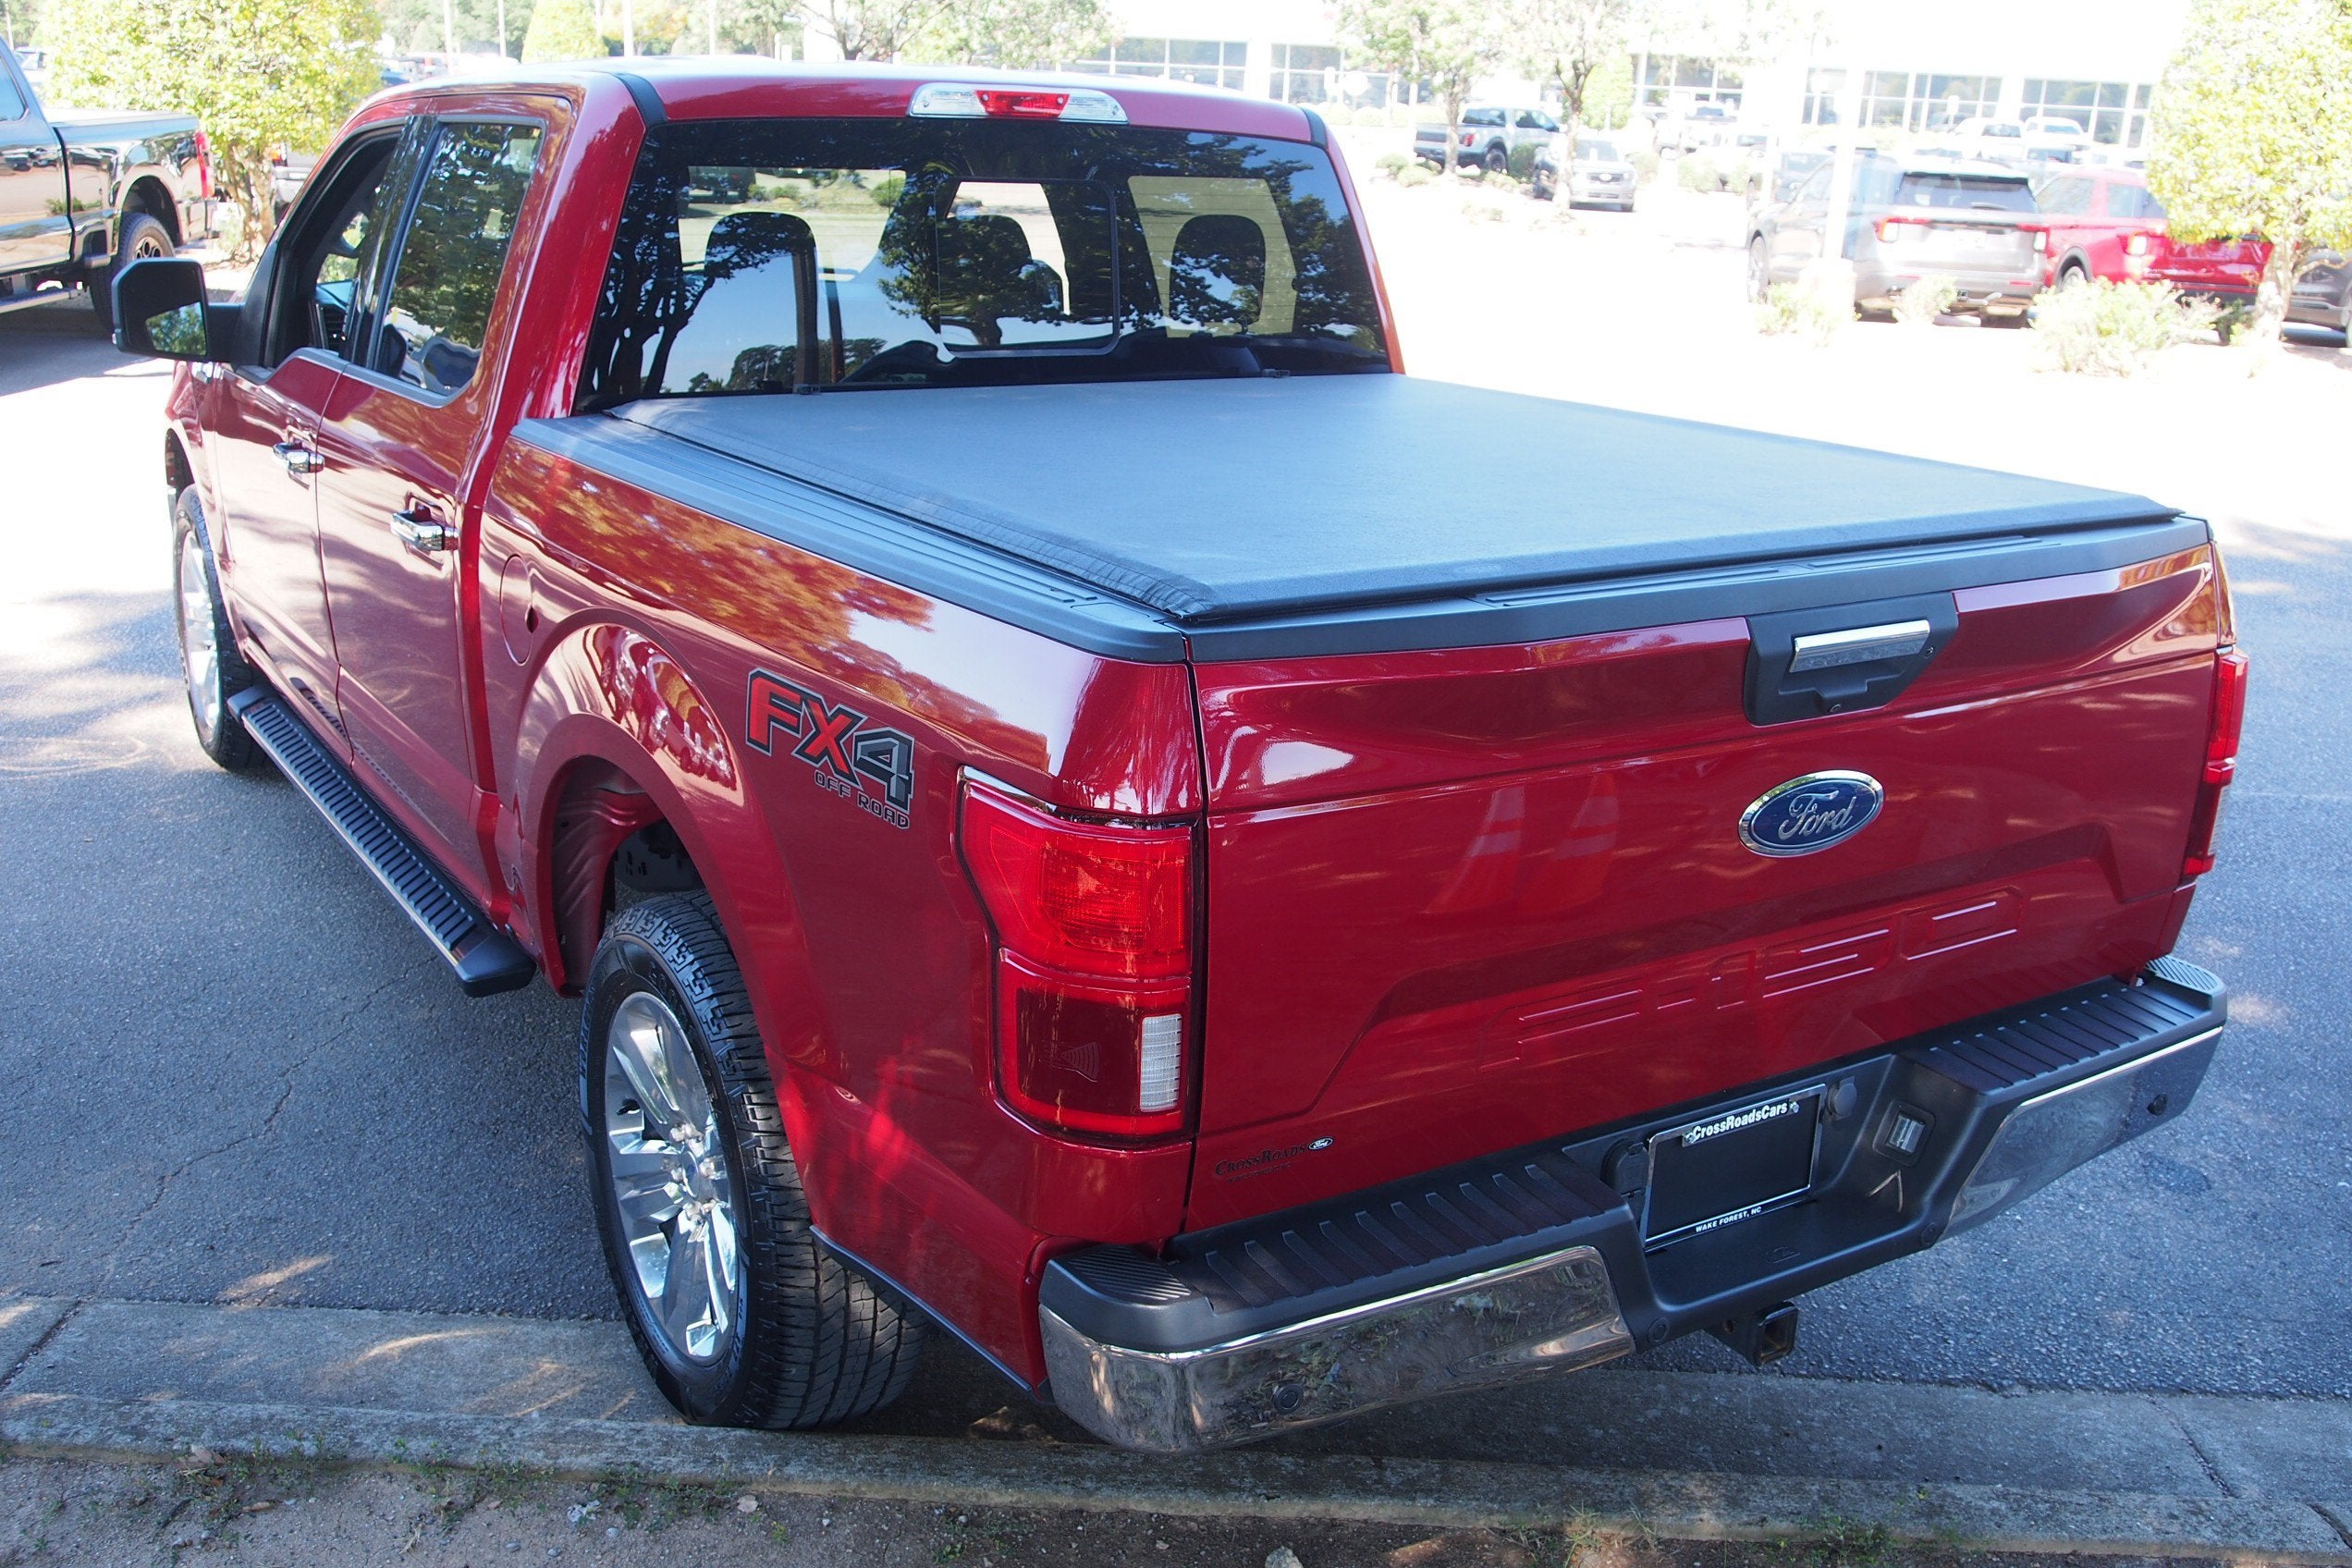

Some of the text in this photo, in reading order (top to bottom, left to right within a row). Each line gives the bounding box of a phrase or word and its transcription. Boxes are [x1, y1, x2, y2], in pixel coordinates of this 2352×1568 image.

[746, 667, 914, 815] FX4
[815, 769, 910, 829] OFF ROAD
[1778, 790, 1856, 840] Ford
[1479, 886, 2027, 1071] F-150
[1692, 1101, 1788, 1141] CrossRoadsCars
[1696, 1207, 1762, 1232] WAKE FOREST, NC
